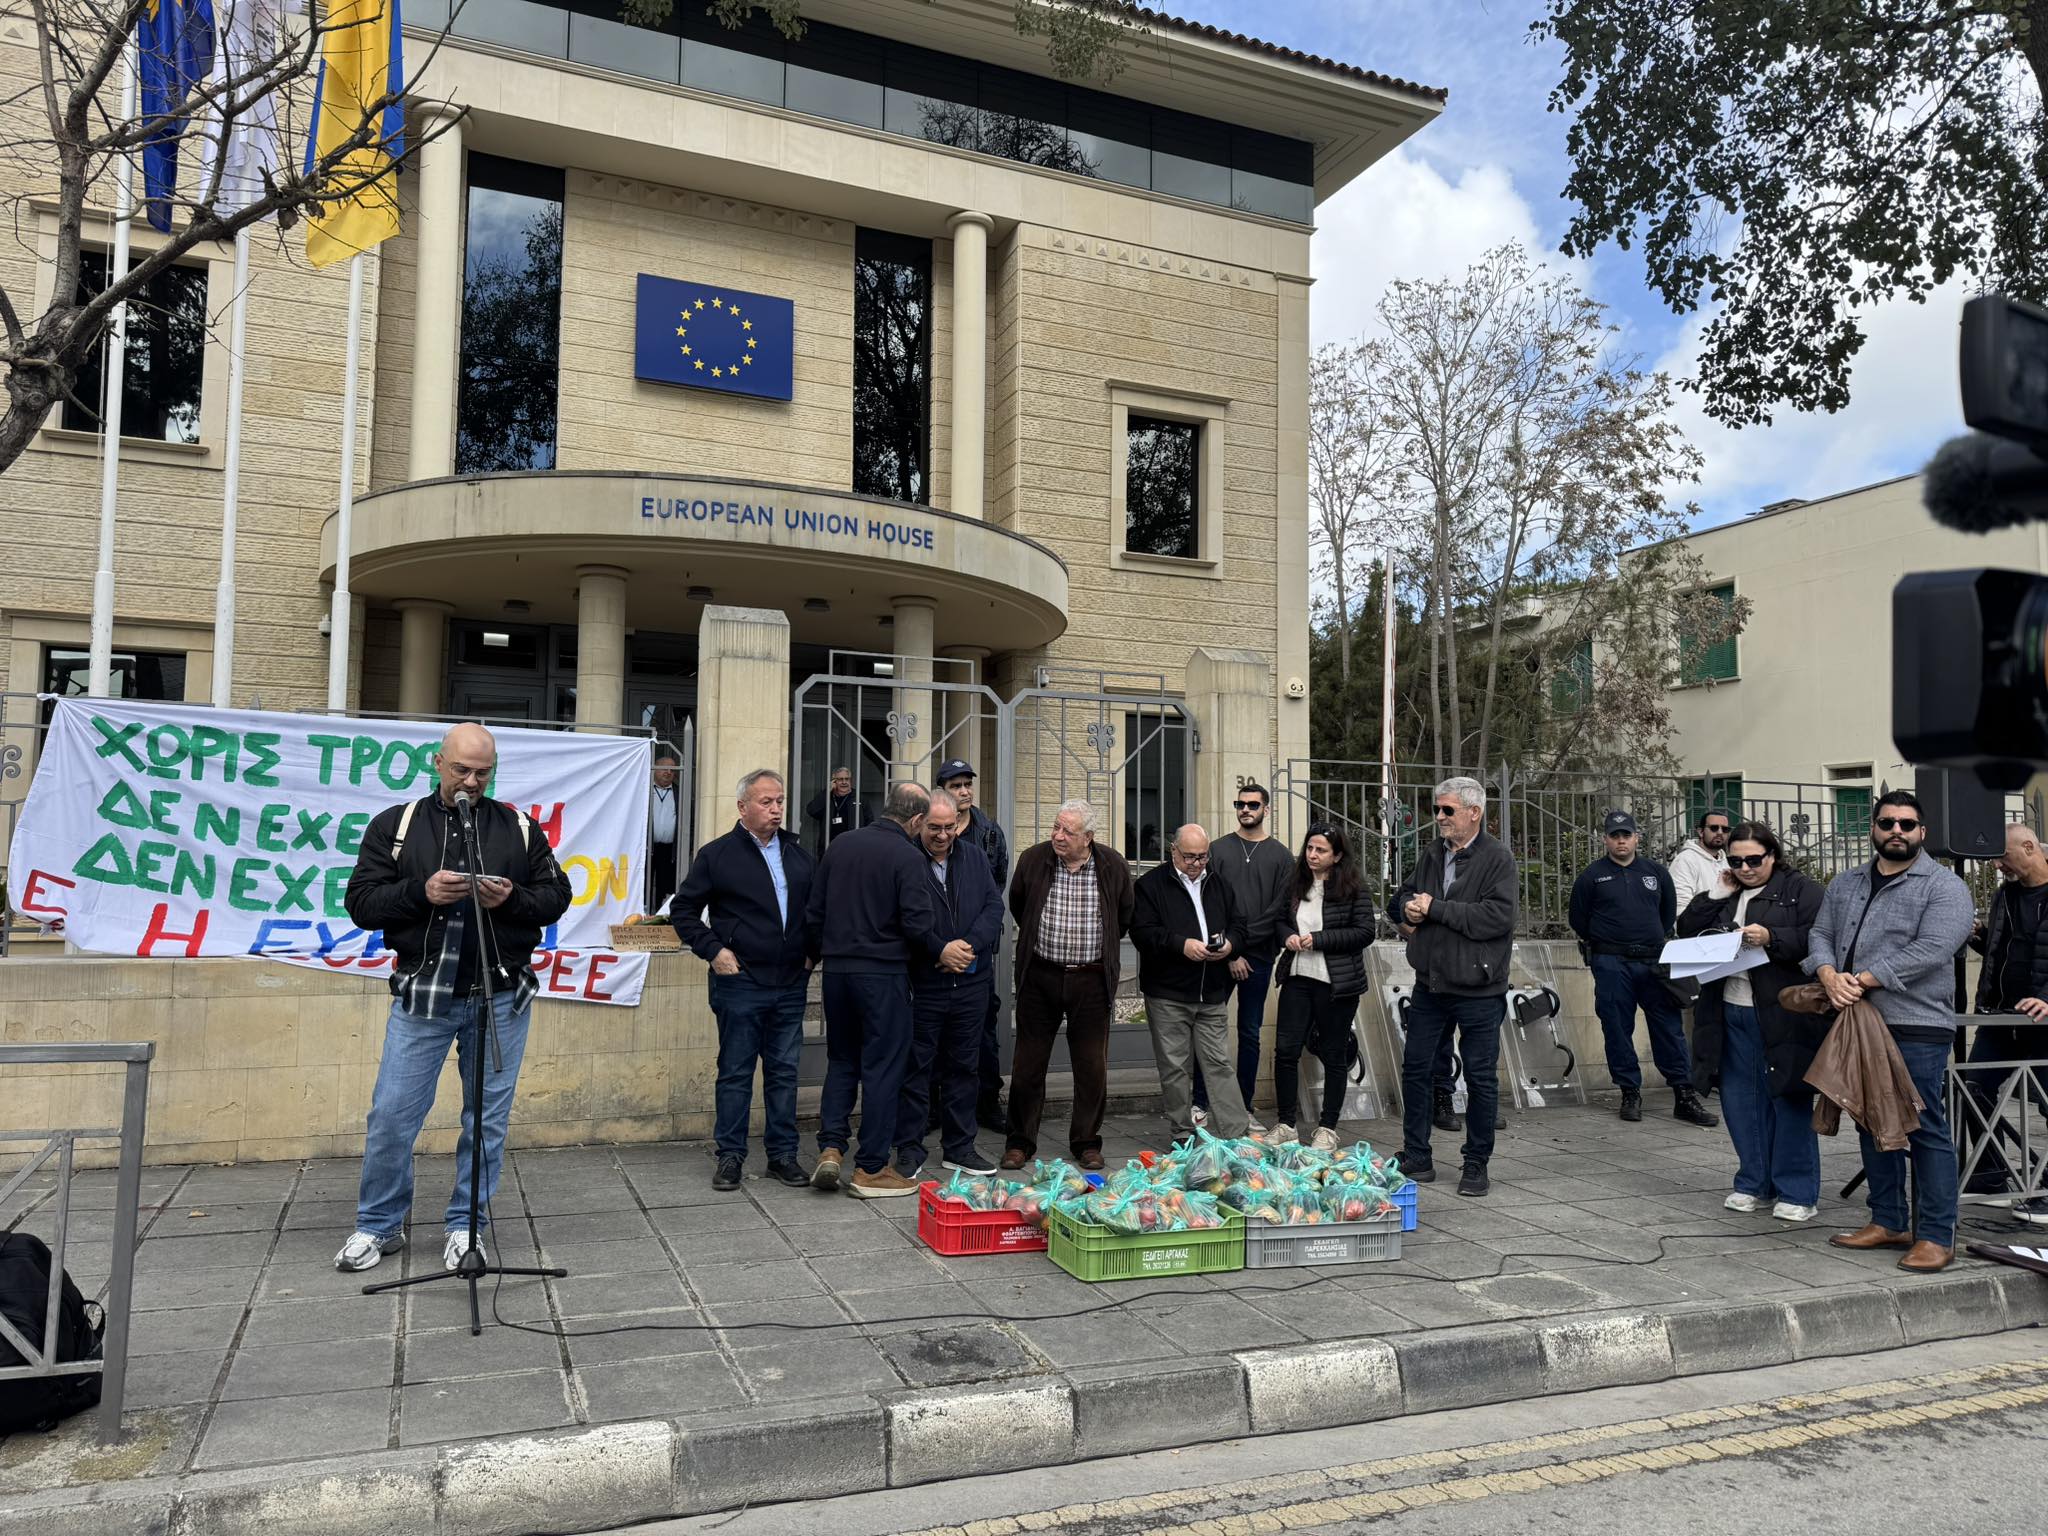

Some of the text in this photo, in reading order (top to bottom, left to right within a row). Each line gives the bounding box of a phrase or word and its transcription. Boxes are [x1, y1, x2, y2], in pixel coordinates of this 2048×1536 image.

[641, 497, 934, 550] EUROPEAN UNION HOUSE
[91, 714, 281, 788] ΧΩΡΙΣ
[1236, 775, 1256, 790] 30
[96, 778, 370, 856] ΔΕΝ ΕΧΕ
[72, 832, 356, 919] ΔΕΝ ΕΧΕ
